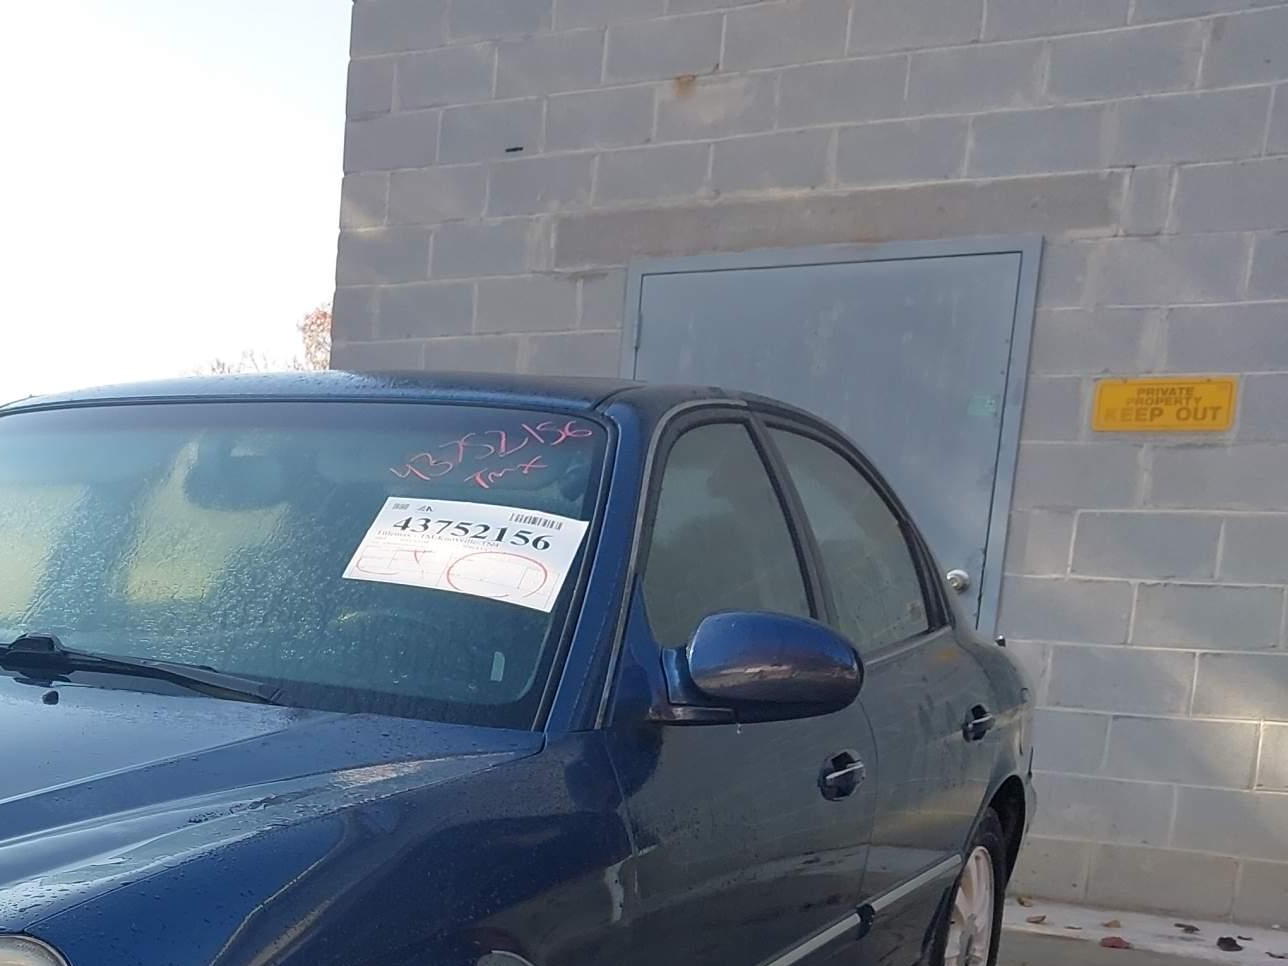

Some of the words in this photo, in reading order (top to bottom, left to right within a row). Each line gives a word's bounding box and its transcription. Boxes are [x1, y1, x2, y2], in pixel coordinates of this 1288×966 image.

[1136, 386, 1195, 396] PRIVATE
[1126, 396, 1202, 406] PROPERTY
[1103, 407, 1164, 422] KEEP
[1175, 406, 1222, 421] OUT
[392, 516, 553, 551] 43752156
